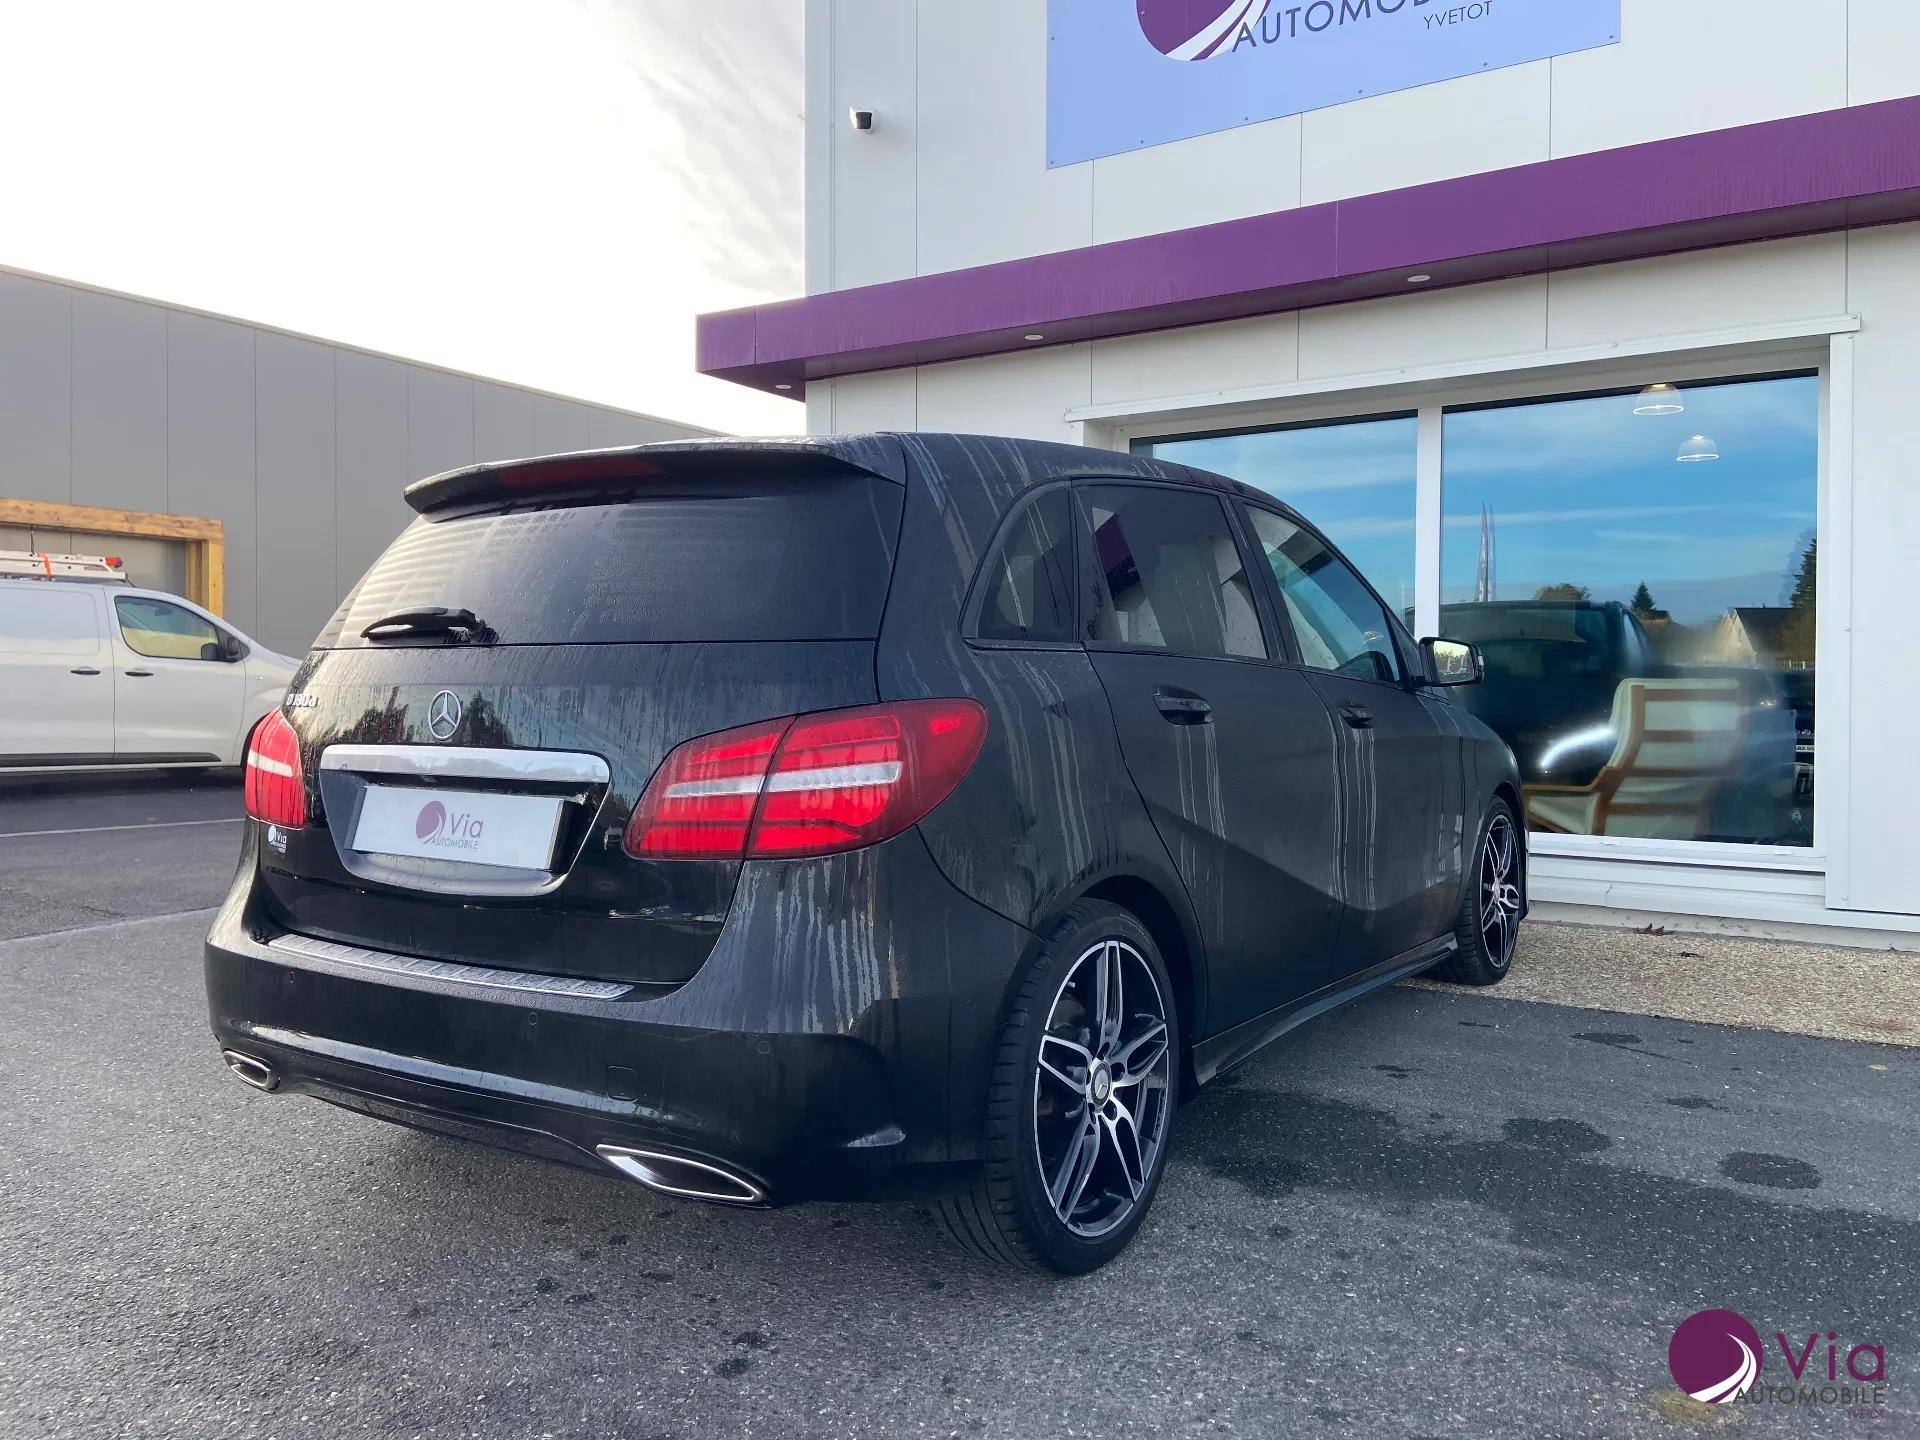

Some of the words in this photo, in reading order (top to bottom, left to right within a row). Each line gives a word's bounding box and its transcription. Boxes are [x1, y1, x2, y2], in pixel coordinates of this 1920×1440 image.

[1231, 0, 1429, 52] AUTOM
[1424, 0, 1493, 30] YVETOT
[450, 813, 484, 838] Via
[431, 837, 480, 849] AUTOMOBILE
